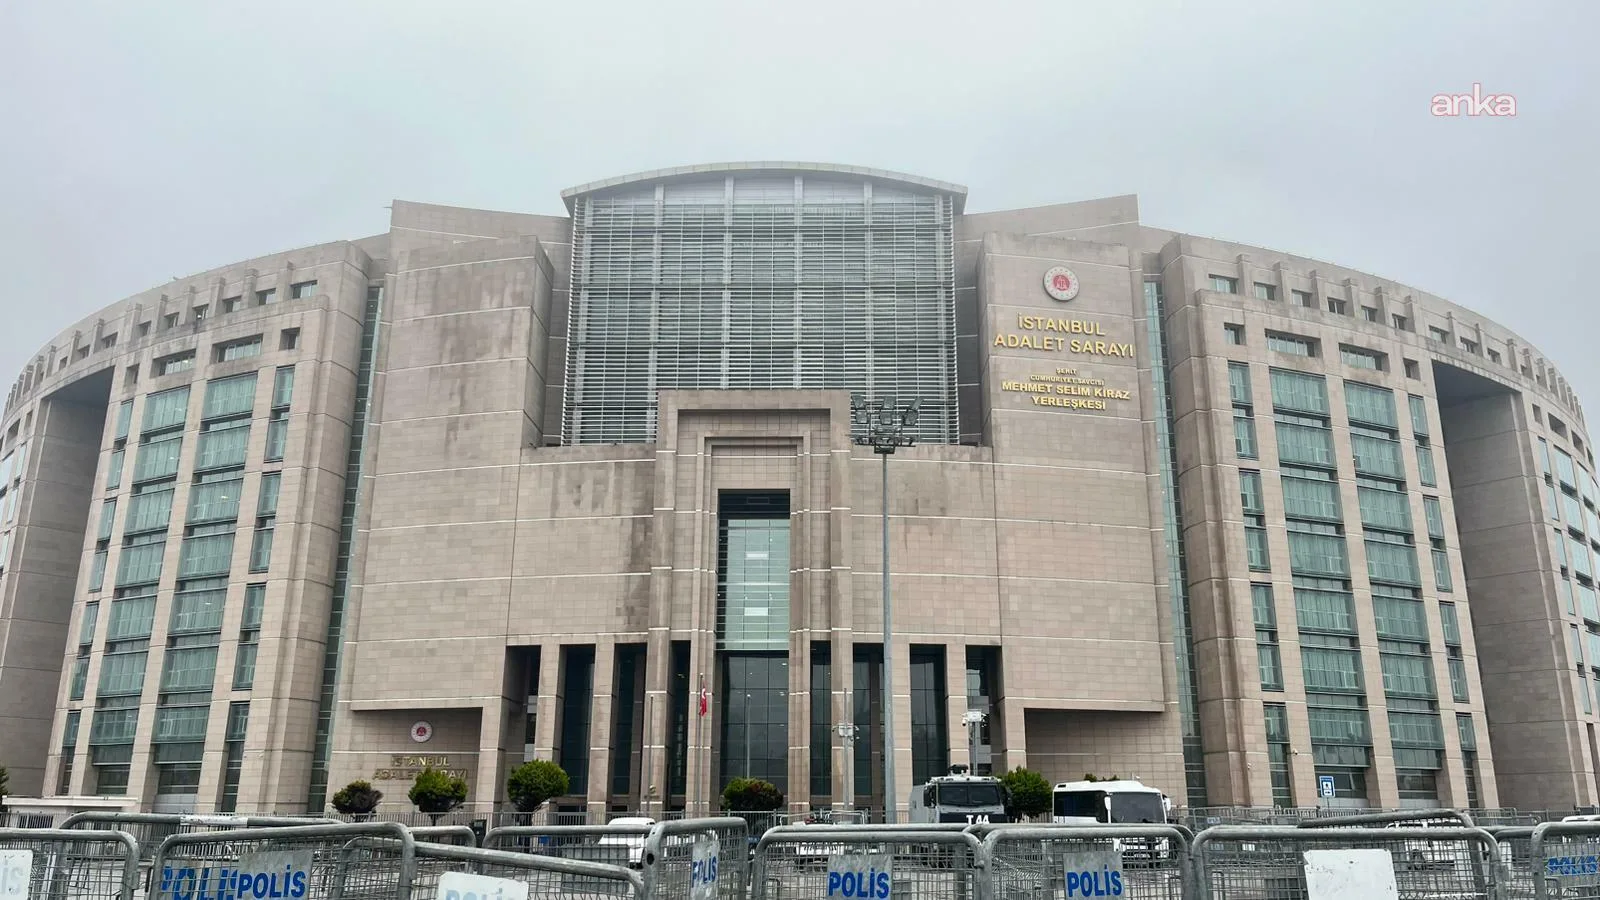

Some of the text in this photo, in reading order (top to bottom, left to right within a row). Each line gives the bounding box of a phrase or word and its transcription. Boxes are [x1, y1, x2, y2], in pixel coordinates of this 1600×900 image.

[1017, 312, 1107, 336] İSTANBUL
[994, 333, 1134, 358] ADALET SARAYI
[1002, 381, 1053, 393] MEHMET
[1056, 384, 1091, 396] SELİM
[373, 769, 421, 780] ADALE
[237, 864, 306, 898] POLİS
[828, 867, 889, 899] POLİS
[1066, 863, 1122, 898] POLİS
